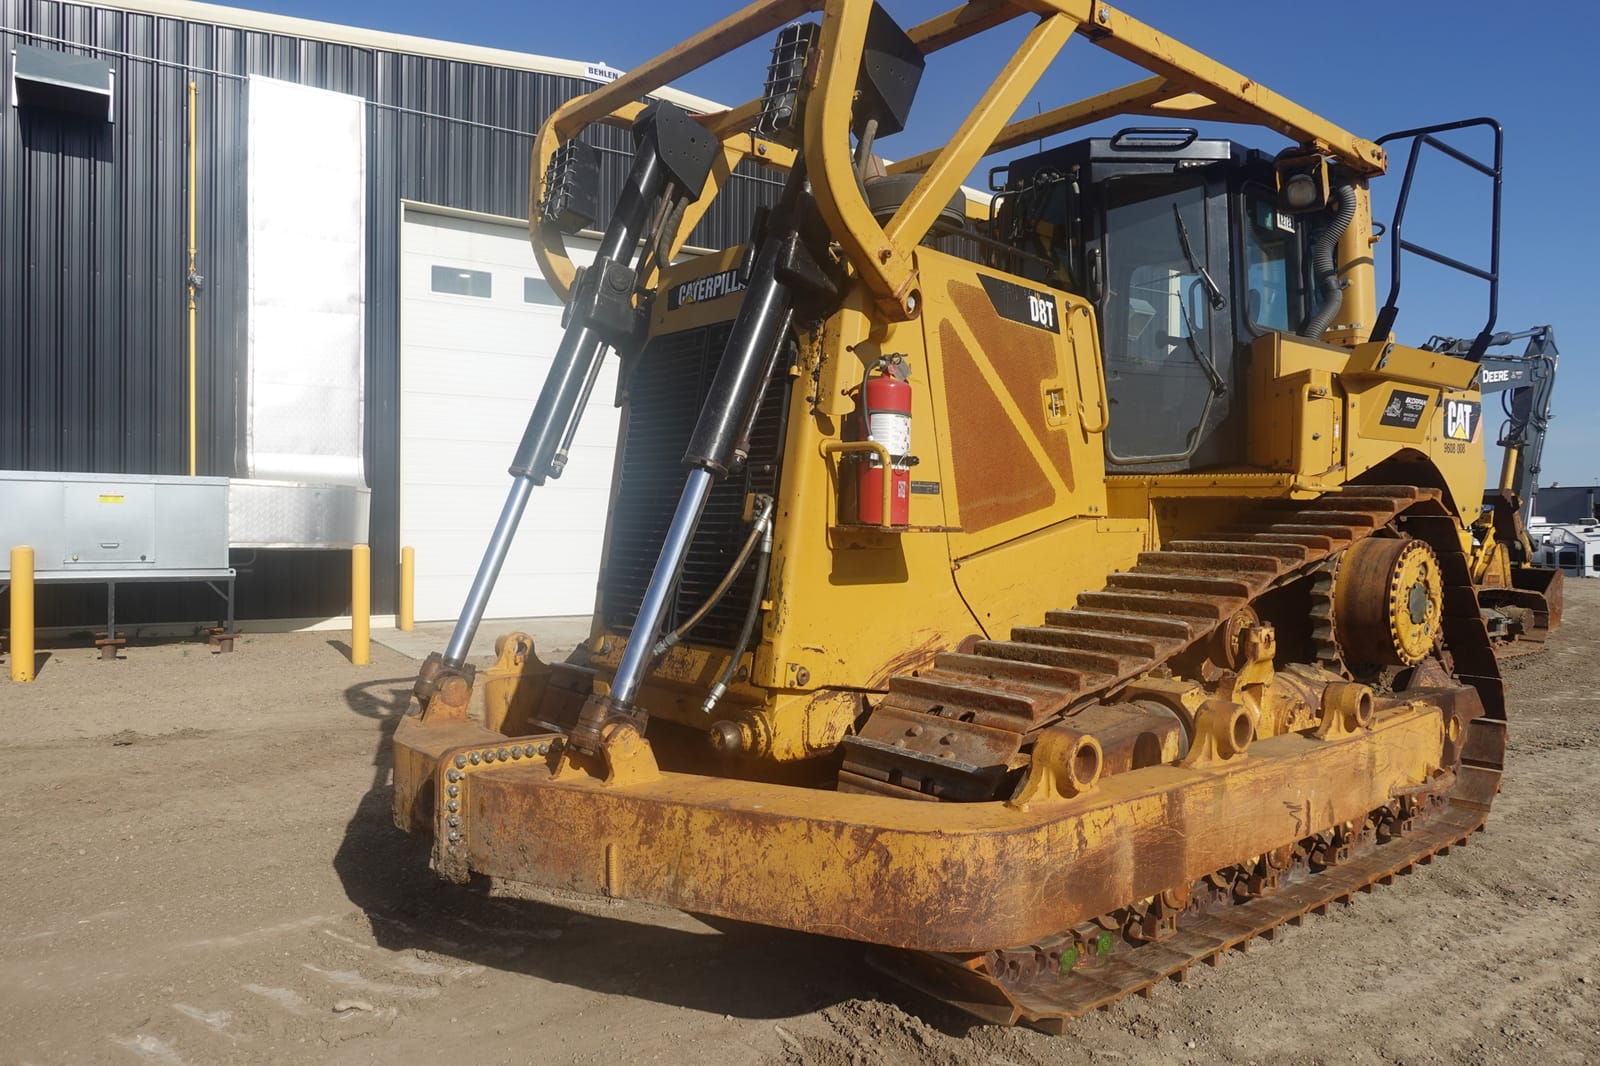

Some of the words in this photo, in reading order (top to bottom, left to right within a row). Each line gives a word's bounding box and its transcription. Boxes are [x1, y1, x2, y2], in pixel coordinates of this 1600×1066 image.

[588, 66, 619, 80] BEHLEN
[1029, 295, 1054, 327] D8T
[1482, 369, 1509, 383] DEERE
[1447, 400, 1473, 440] CAT
